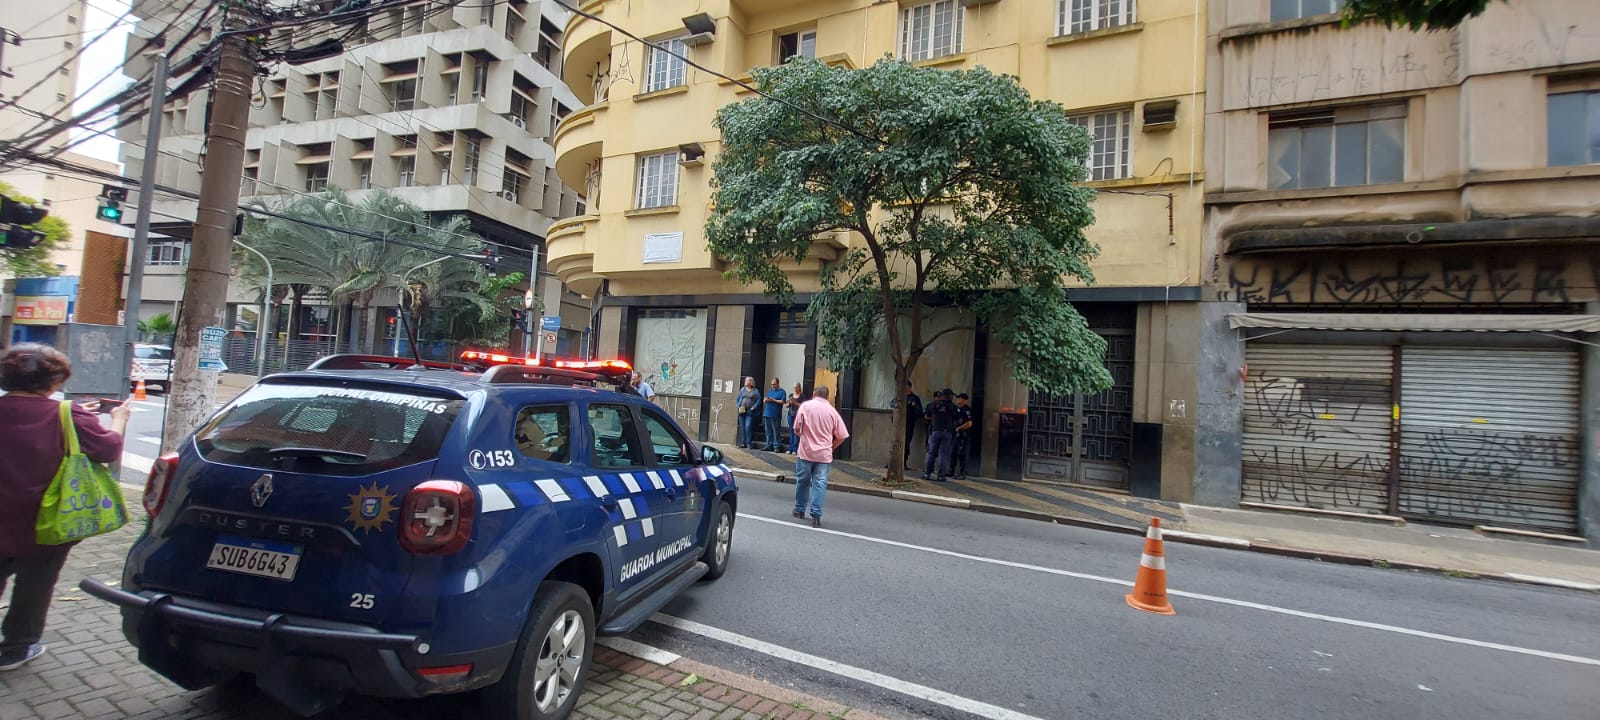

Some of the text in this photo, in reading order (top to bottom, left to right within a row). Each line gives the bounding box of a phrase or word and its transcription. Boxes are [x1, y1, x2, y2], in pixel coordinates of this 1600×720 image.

[485, 449, 514, 467] 153
[199, 512, 315, 538] DUSTER
[216, 545, 290, 575] SUB6G43
[620, 534, 692, 583] GUARDA MUNICIPAL
[350, 592, 376, 610] 25
